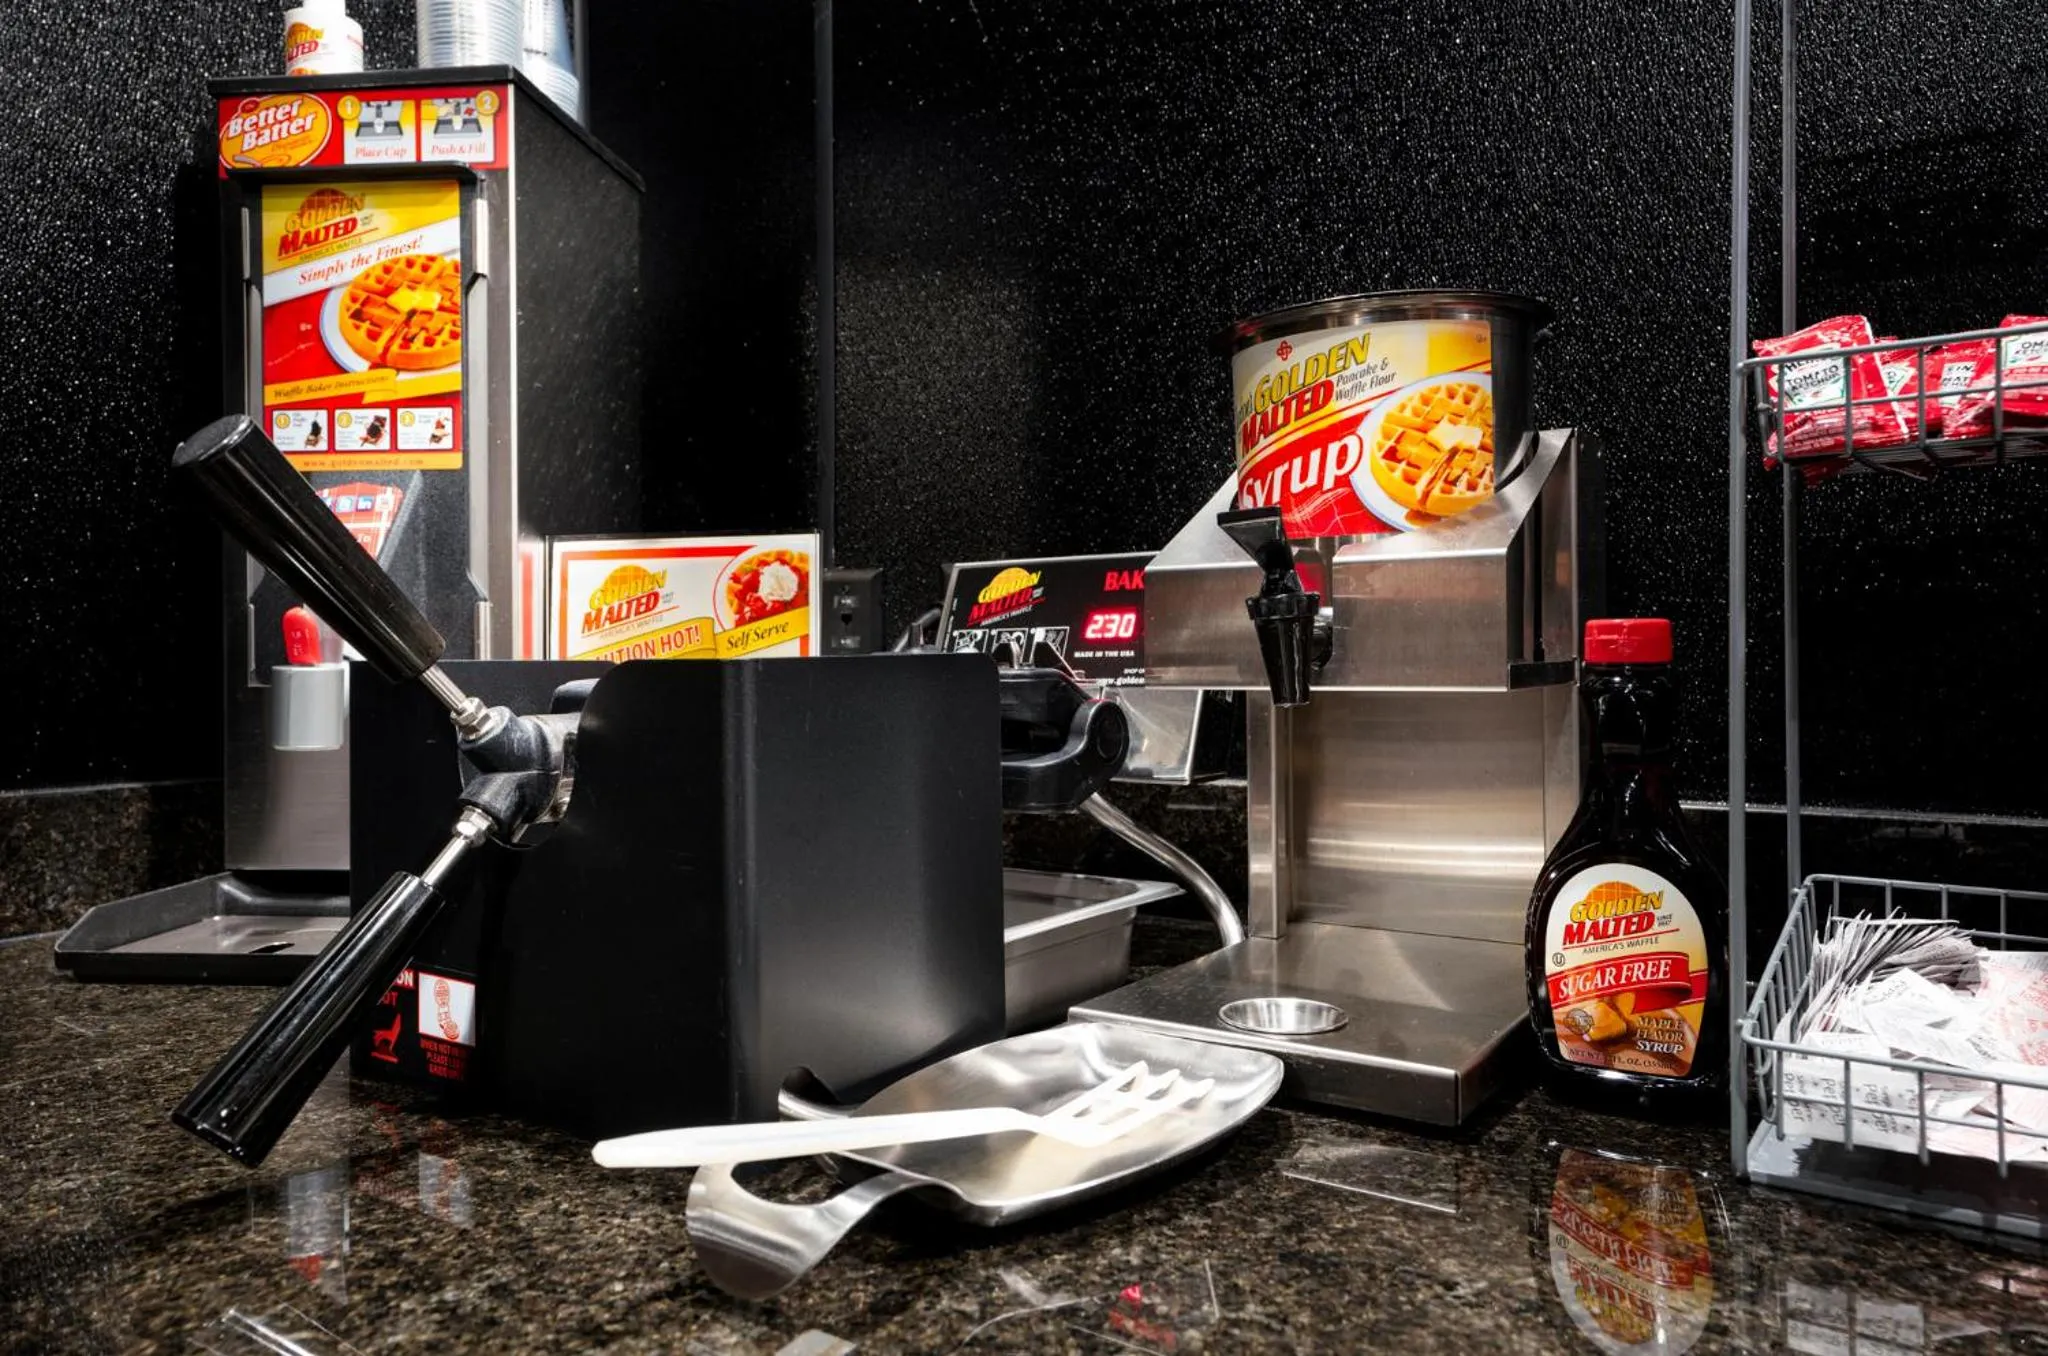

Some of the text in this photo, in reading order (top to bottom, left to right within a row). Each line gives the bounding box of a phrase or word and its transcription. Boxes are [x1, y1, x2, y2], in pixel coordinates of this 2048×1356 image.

[227, 98, 303, 139] Better
[241, 112, 317, 152] Batter
[355, 146, 408, 158] Place Cup
[432, 144, 455, 156] Push
[468, 142, 487, 155] Fill
[285, 193, 366, 233] GOLDEN
[277, 216, 358, 257] MALTED
[298, 234, 424, 285] Simply the Finest!
[1254, 332, 1371, 415] GOLDEN
[1335, 372, 1396, 400] Waffle Flour
[1336, 357, 1389, 387] Pancake &
[1241, 379, 1335, 459] MALTED
[589, 568, 668, 611] GOLDEN
[581, 591, 660, 634] MALTED
[596, 624, 701, 661] UTION HOT!
[726, 621, 789, 650] Self Serve
[1074, 650, 1093, 658] MADE
[1095, 650, 1103, 658] IN
[1105, 650, 1119, 658] THE
[1569, 890, 1664, 923] GOLDEN
[1562, 911, 1655, 946] MALTED
[1582, 936, 1660, 955] AMERICA'S WAFFLE
[1559, 959, 1673, 999] SUGAR FREE
[1635, 1028, 1683, 1042] FLAVOR
[1636, 1015, 1682, 1029] MAPLE
[1635, 1040, 1684, 1054] SYRUP
